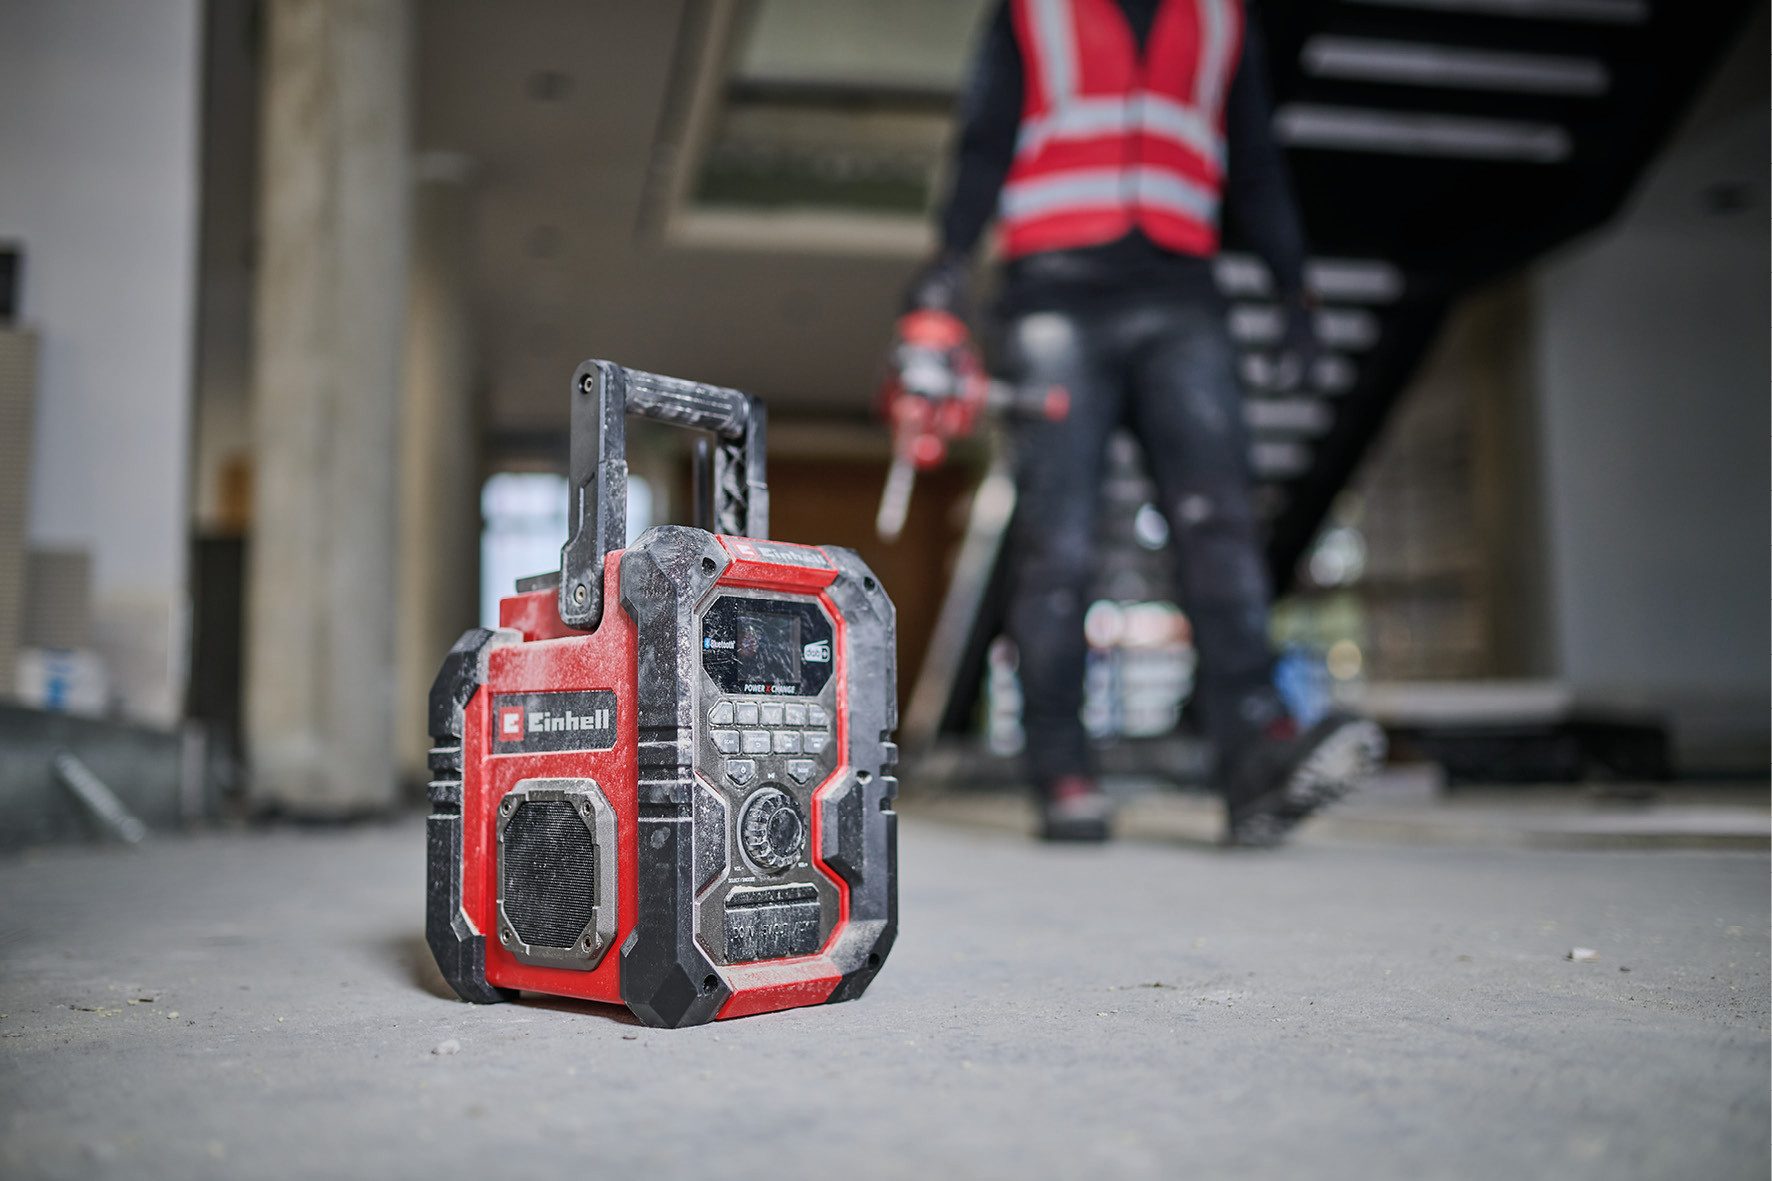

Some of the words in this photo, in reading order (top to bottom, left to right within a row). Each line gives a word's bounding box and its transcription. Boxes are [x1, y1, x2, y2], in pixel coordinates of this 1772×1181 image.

[759, 547, 828, 564] Einhell
[744, 684, 765, 692] POWER
[772, 684, 796, 693] CHANGE
[528, 708, 609, 732] Einhell
